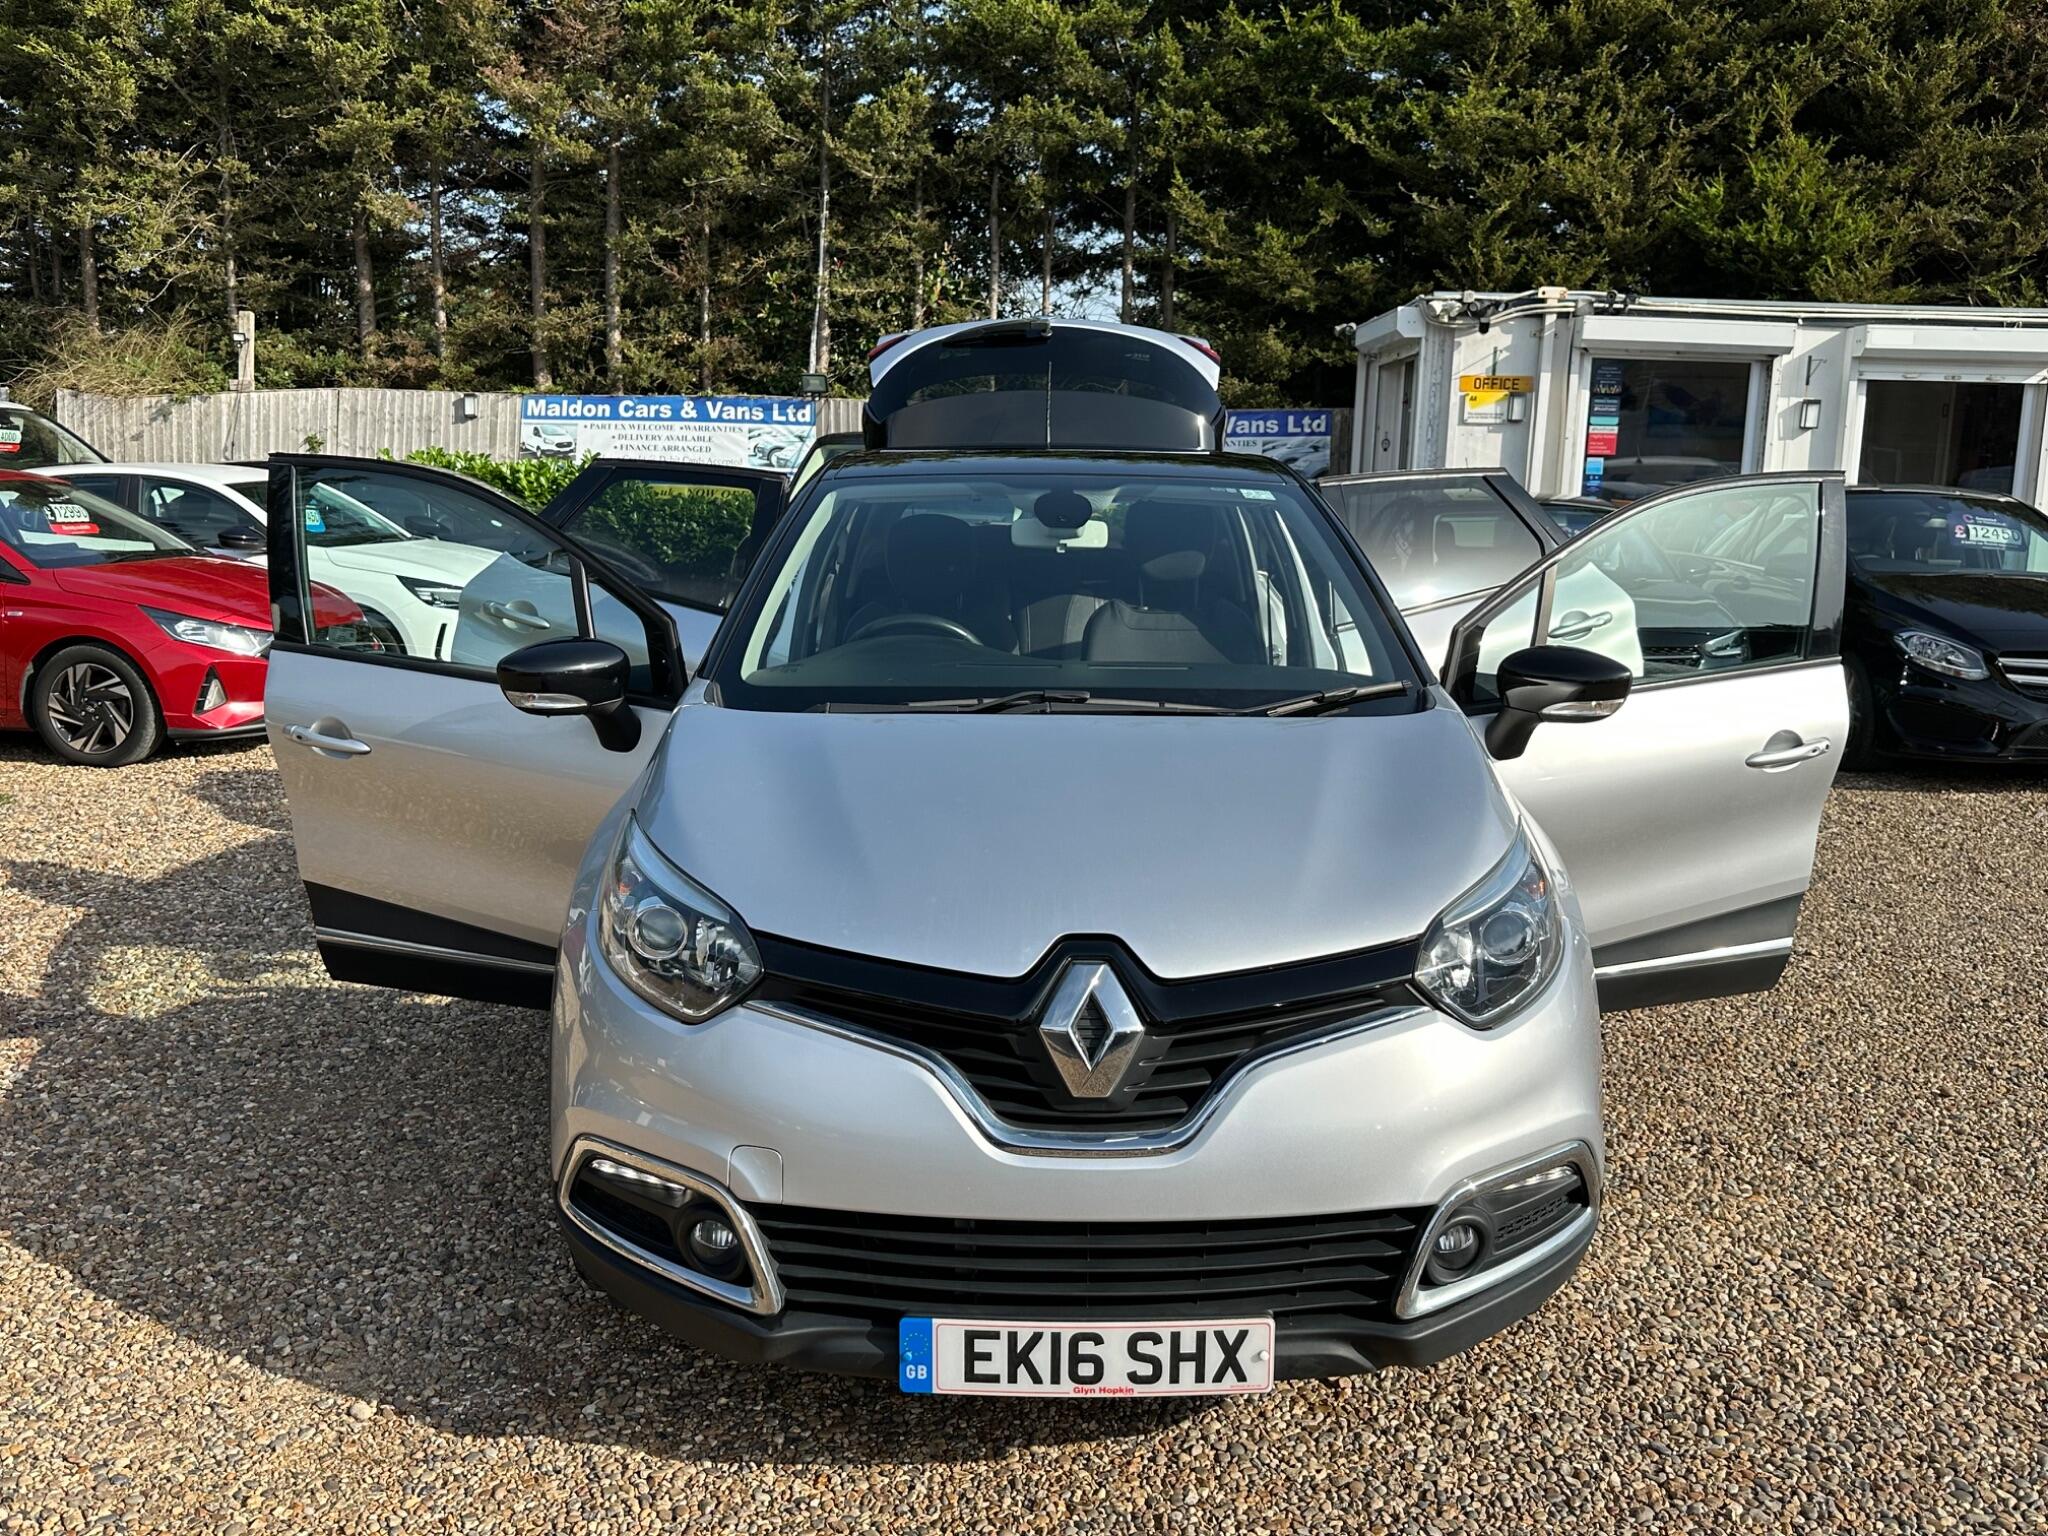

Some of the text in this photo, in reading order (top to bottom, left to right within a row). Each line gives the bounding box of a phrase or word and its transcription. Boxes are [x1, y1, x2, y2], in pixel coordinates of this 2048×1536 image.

[1474, 378, 1521, 390] OFFICE
[527, 398, 812, 423] Maldon Cars & Vans Ltd
[590, 423, 611, 431] PART
[614, 423, 626, 431] EX
[628, 424, 674, 432] WELCOME
[1287, 415, 1327, 433] Ltd
[618, 433, 713, 443] DELIVERY AVAILABLE
[620, 443, 712, 453] FINANCE ARRANGED
[963, 1329, 1250, 1385] EK16 SHX
[906, 1364, 928, 1380] GB
[1073, 1385, 1135, 1396] Glyn Hopkin
